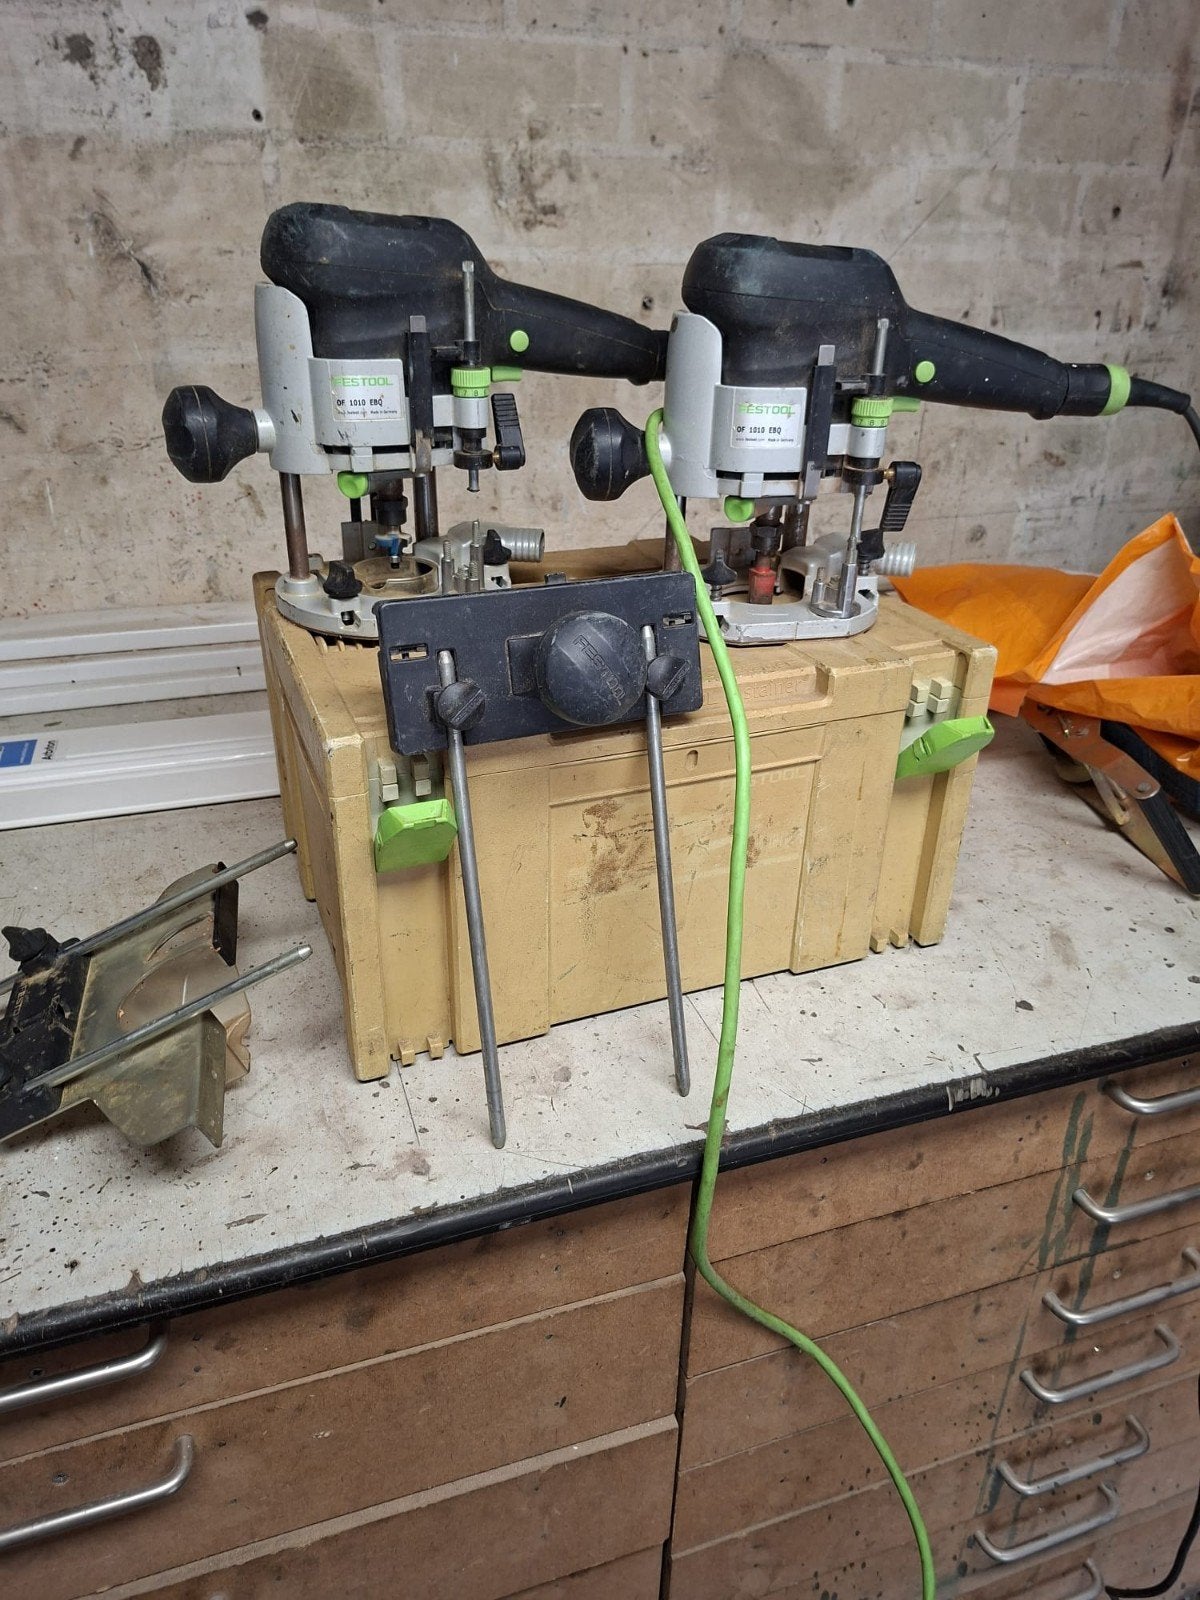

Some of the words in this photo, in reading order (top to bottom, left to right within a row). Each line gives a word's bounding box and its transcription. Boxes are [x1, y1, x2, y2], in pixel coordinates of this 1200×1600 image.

[331, 376, 394, 387] FESTOOL
[336, 399, 346, 407] OF
[349, 399, 367, 407] 1010
[369, 398, 384, 408] EBQ
[738, 403, 796, 415] FESTOOL
[736, 426, 746, 434] OF
[749, 426, 766, 434] 1010
[768, 426, 782, 436] EBQ
